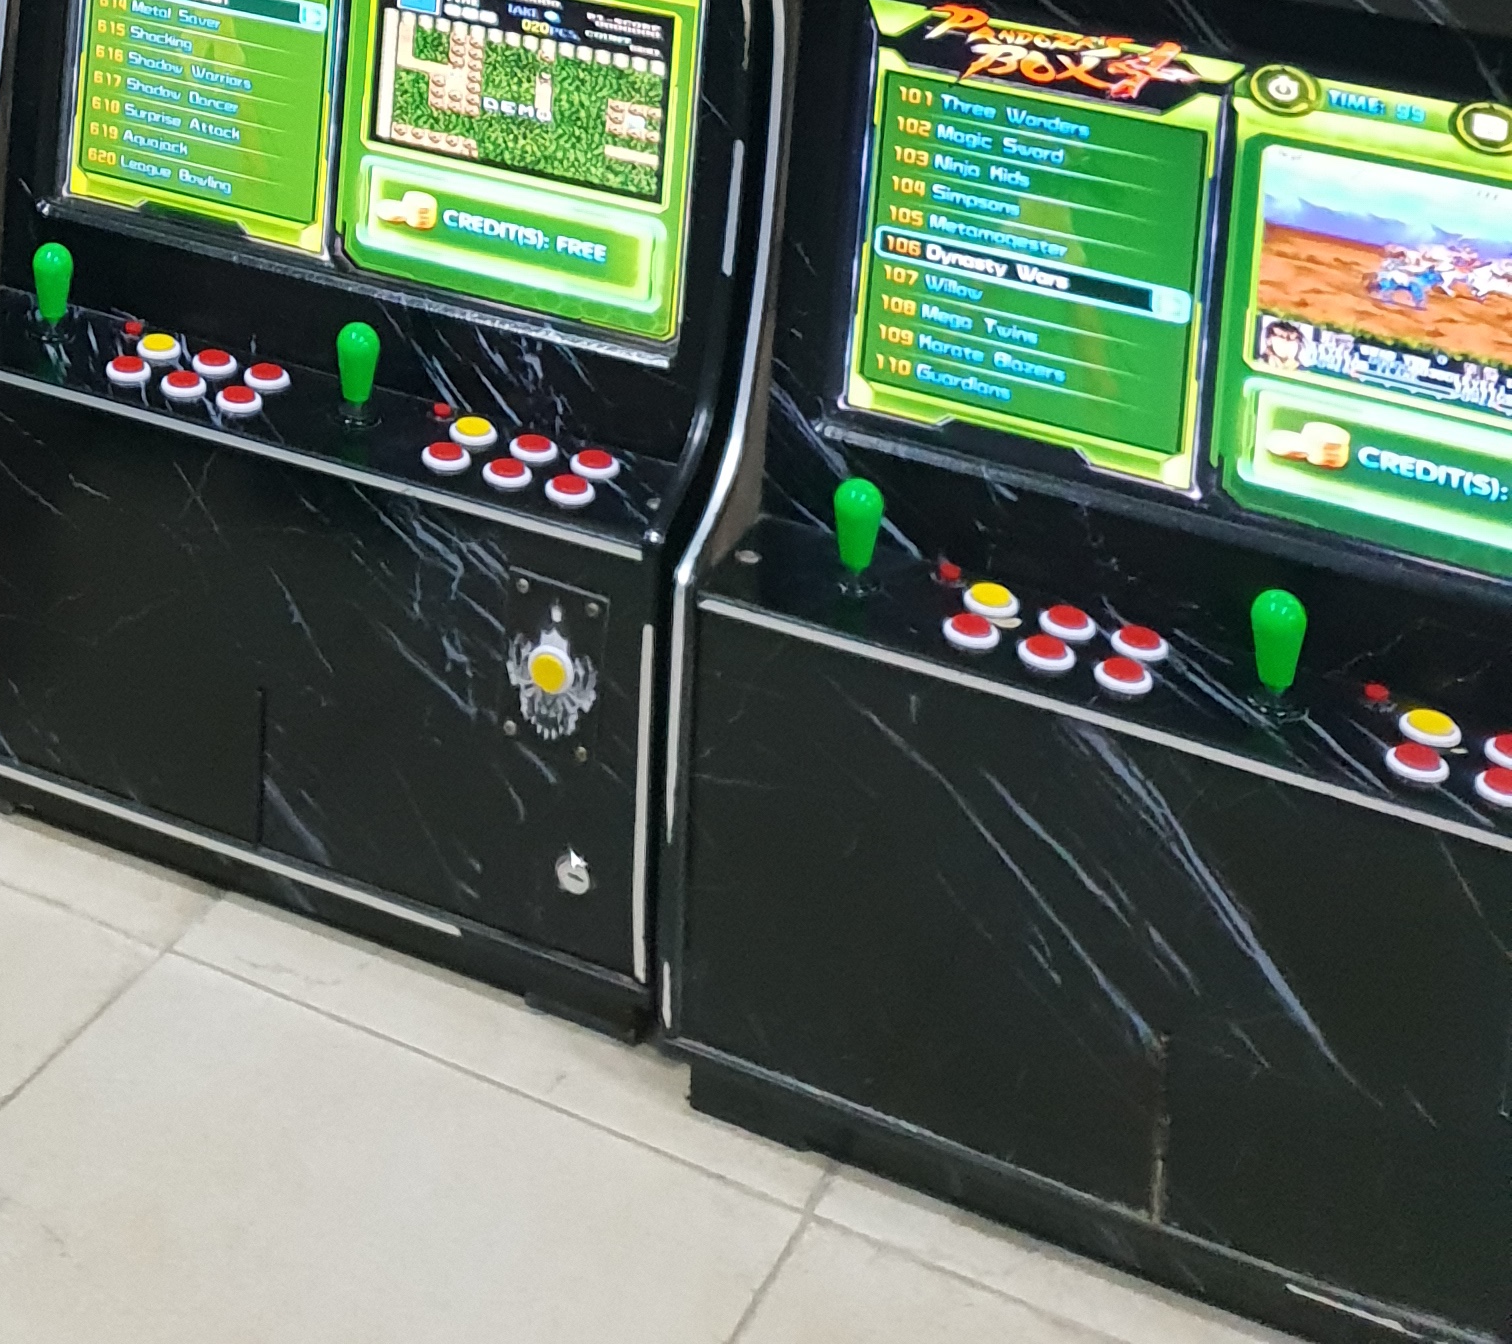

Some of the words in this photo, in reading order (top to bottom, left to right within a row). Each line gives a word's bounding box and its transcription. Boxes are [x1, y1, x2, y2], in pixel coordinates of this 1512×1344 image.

[131, 0, 172, 21] Metal
[178, 10, 221, 32] Saver
[130, 25, 193, 53] Shocking
[128, 51, 183, 75] Shadow
[191, 64, 252, 90] Warriors
[959, 43, 1112, 90] BOX
[126, 77, 181, 101] Shadow
[189, 90, 239, 113] Dancer
[482, 96, 553, 122] DEMO
[899, 85, 934, 107] 101
[940, 93, 996, 120] Three
[1006, 105, 1091, 138] Wonders
[1326, 88, 1387, 115] TIME:
[124, 102, 182, 128] Surprise
[189, 117, 240, 140] Attack
[897, 115, 931, 138] 102
[936, 123, 994, 151] Magic
[1003, 137, 1064, 165] Sword
[122, 128, 188, 156] Aquajack
[120, 154, 172, 179] League
[178, 168, 232, 195] Bowling
[894, 145, 929, 168] 103
[933, 154, 981, 180] Ninja
[989, 163, 1030, 188] Kids
[889, 205, 924, 228] 105
[891, 175, 926, 198] 104
[931, 184, 1021, 217] Simpsons
[443, 208, 550, 251] CREDIT(S):
[556, 235, 607, 264] FREE
[883, 264, 919, 287] 107
[924, 273, 984, 302] Willow
[886, 234, 922, 258] 106
[925, 243, 1008, 279] Dynasty
[1016, 262, 1071, 291] Wars
[881, 294, 917, 317] 108
[920, 302, 973, 331] Mega
[984, 317, 1039, 345] Twins
[878, 323, 914, 346] 109
[918, 333, 985, 364] Karate
[993, 351, 1066, 383] Blazers
[875, 353, 912, 376] 110
[915, 363, 1012, 402] Guardians
[1356, 446, 1509, 502] CREDIT(S):
